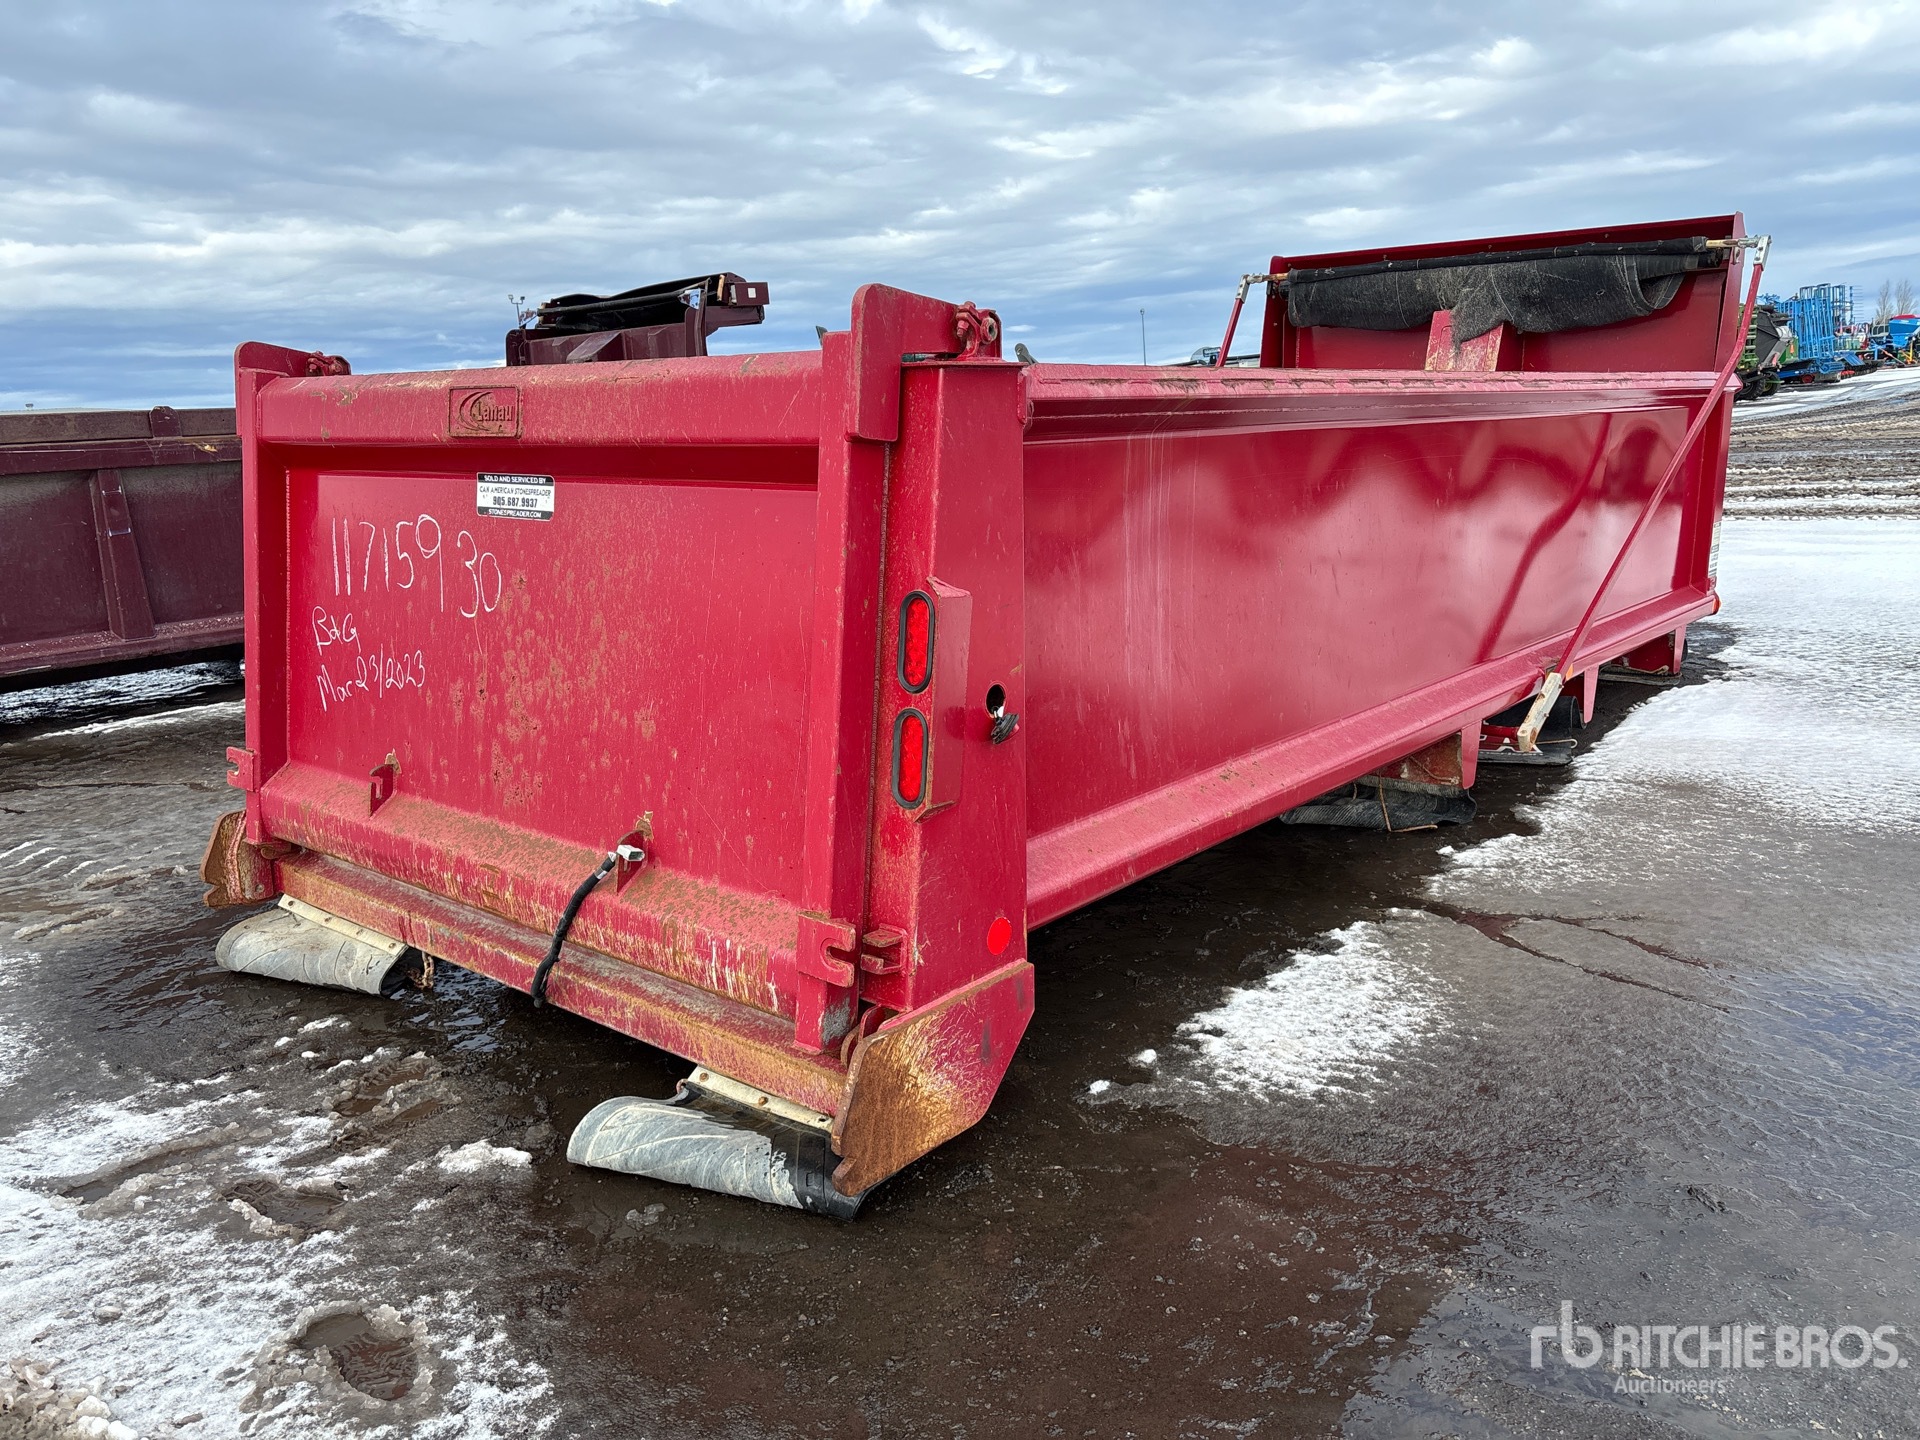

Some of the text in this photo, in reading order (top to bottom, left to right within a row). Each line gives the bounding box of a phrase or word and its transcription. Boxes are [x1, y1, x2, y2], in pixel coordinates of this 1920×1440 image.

[499, 475, 510, 483] AND
[511, 476, 538, 484] SERVICED
[491, 486, 514, 494] AMERICAN
[514, 488, 552, 496] STONESPREADER
[493, 496, 538, 508] 905.687.9937
[488, 508, 542, 518] STONESPREADER.COM
